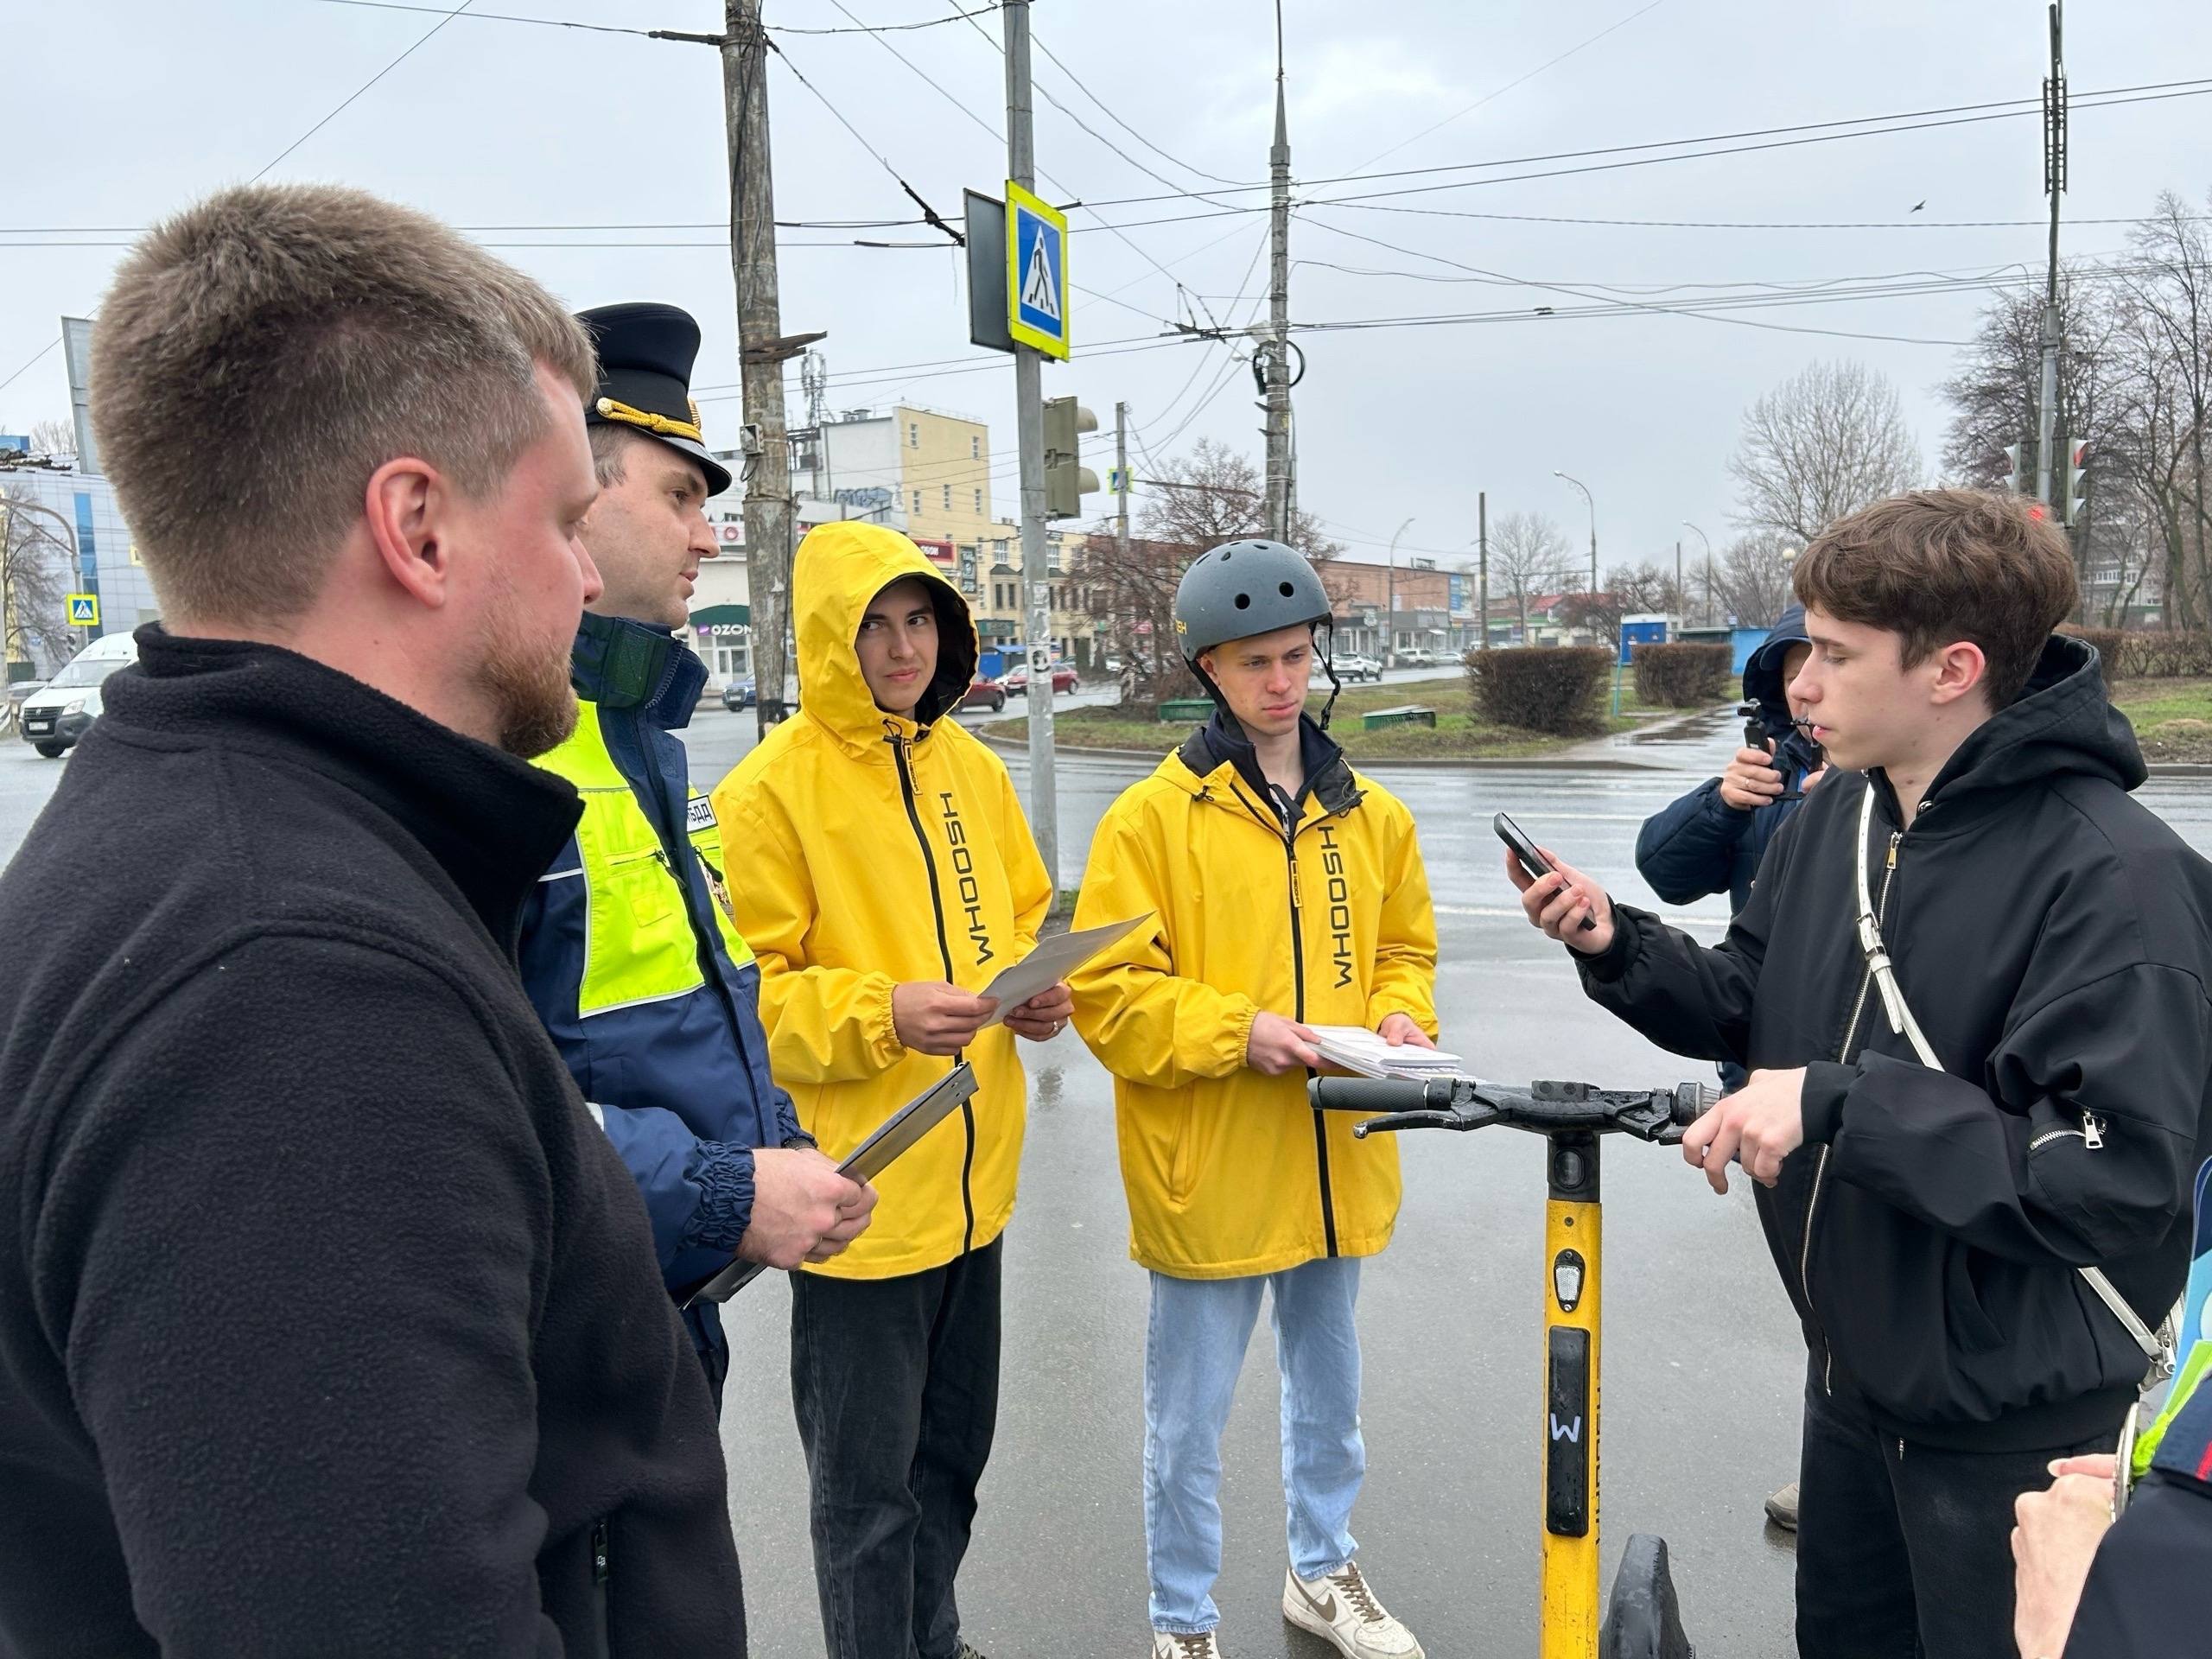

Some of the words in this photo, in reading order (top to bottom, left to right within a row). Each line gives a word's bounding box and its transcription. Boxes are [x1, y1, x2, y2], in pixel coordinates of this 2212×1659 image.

[688, 804, 713, 823] БДД
[939, 792, 995, 966] WHOOSH
[1317, 826, 1352, 989] WHOOSH
[1550, 1413, 1581, 1442] W
